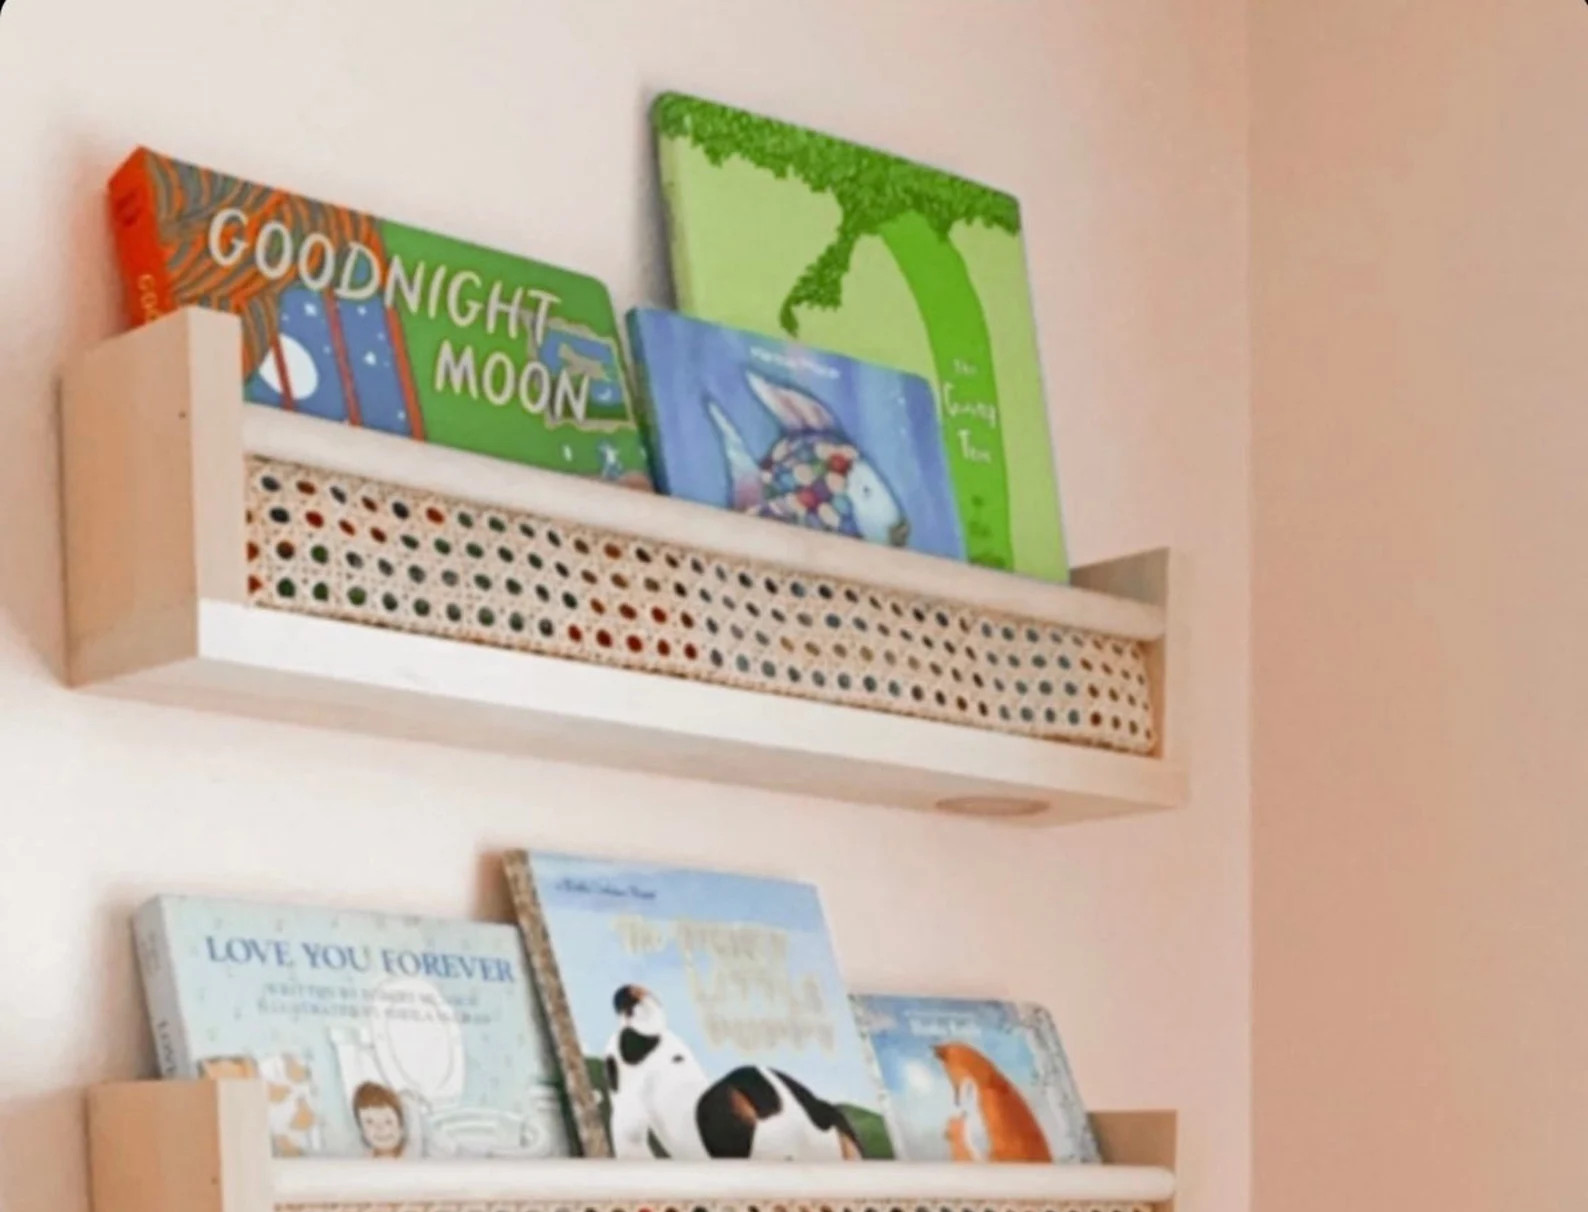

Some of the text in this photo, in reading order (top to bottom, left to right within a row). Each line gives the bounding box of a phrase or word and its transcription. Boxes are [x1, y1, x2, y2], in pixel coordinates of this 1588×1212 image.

[208, 207, 562, 346] GOODNIGHT
[434, 339, 590, 424] MOON
[204, 935, 515, 984] LOVE YOU FOREVER
